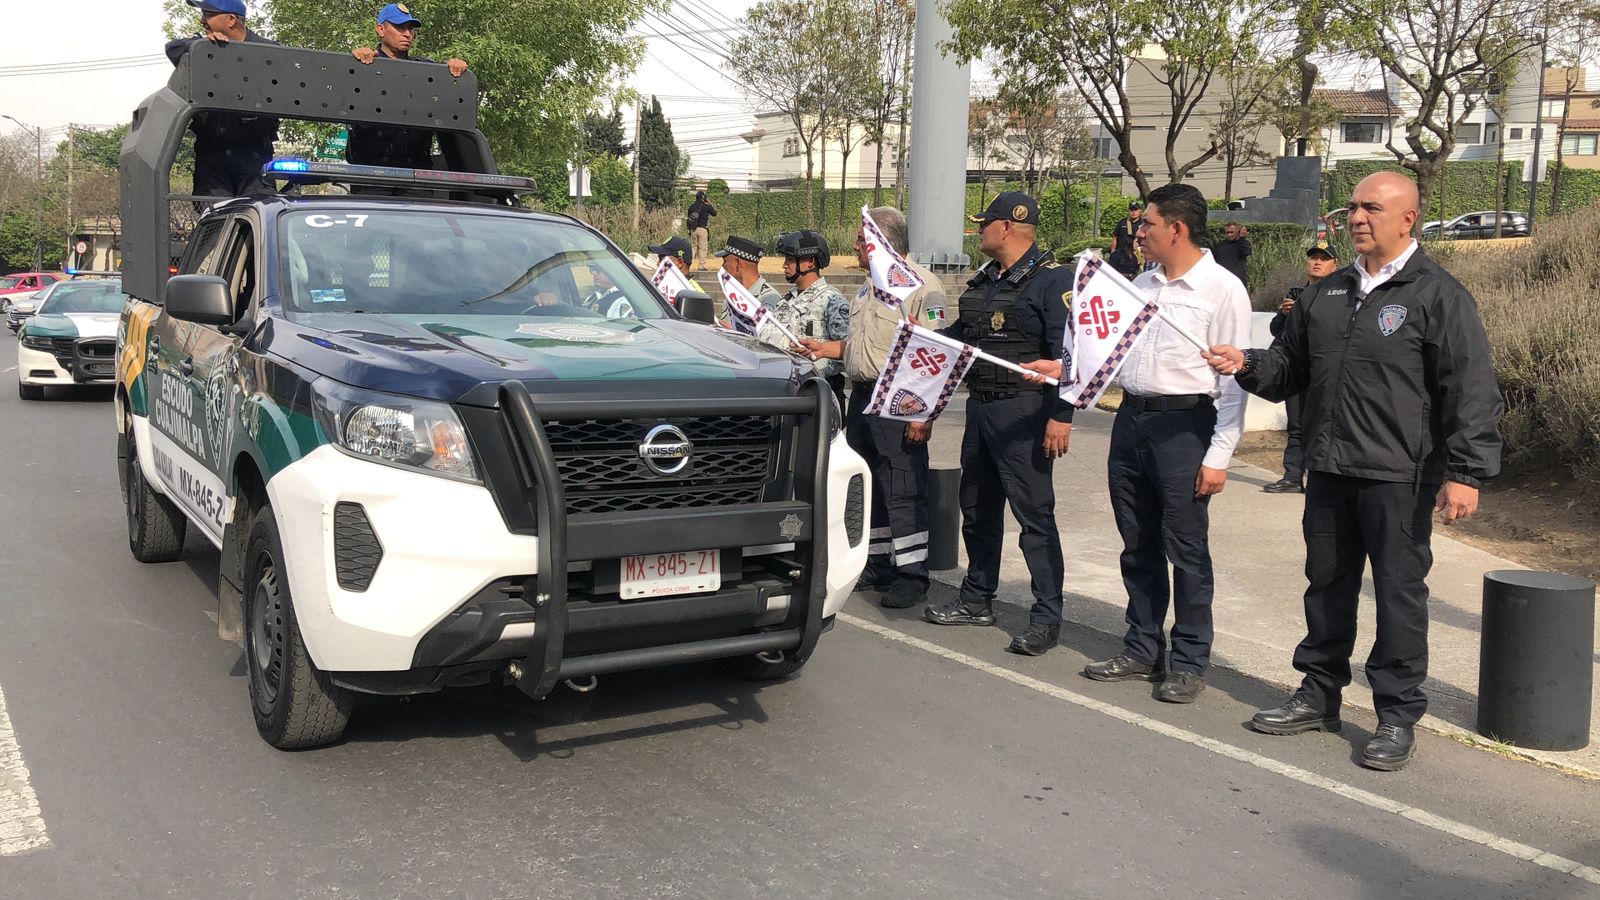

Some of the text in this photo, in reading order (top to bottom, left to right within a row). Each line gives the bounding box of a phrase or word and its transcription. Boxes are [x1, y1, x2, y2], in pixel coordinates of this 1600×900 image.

[305, 214, 369, 228] C-7
[162, 372, 193, 418] ESCUDO
[155, 398, 207, 460] CUAJIMALPA
[647, 446, 690, 456] NISSAN
[625, 550, 716, 581] MX-845-Z1
